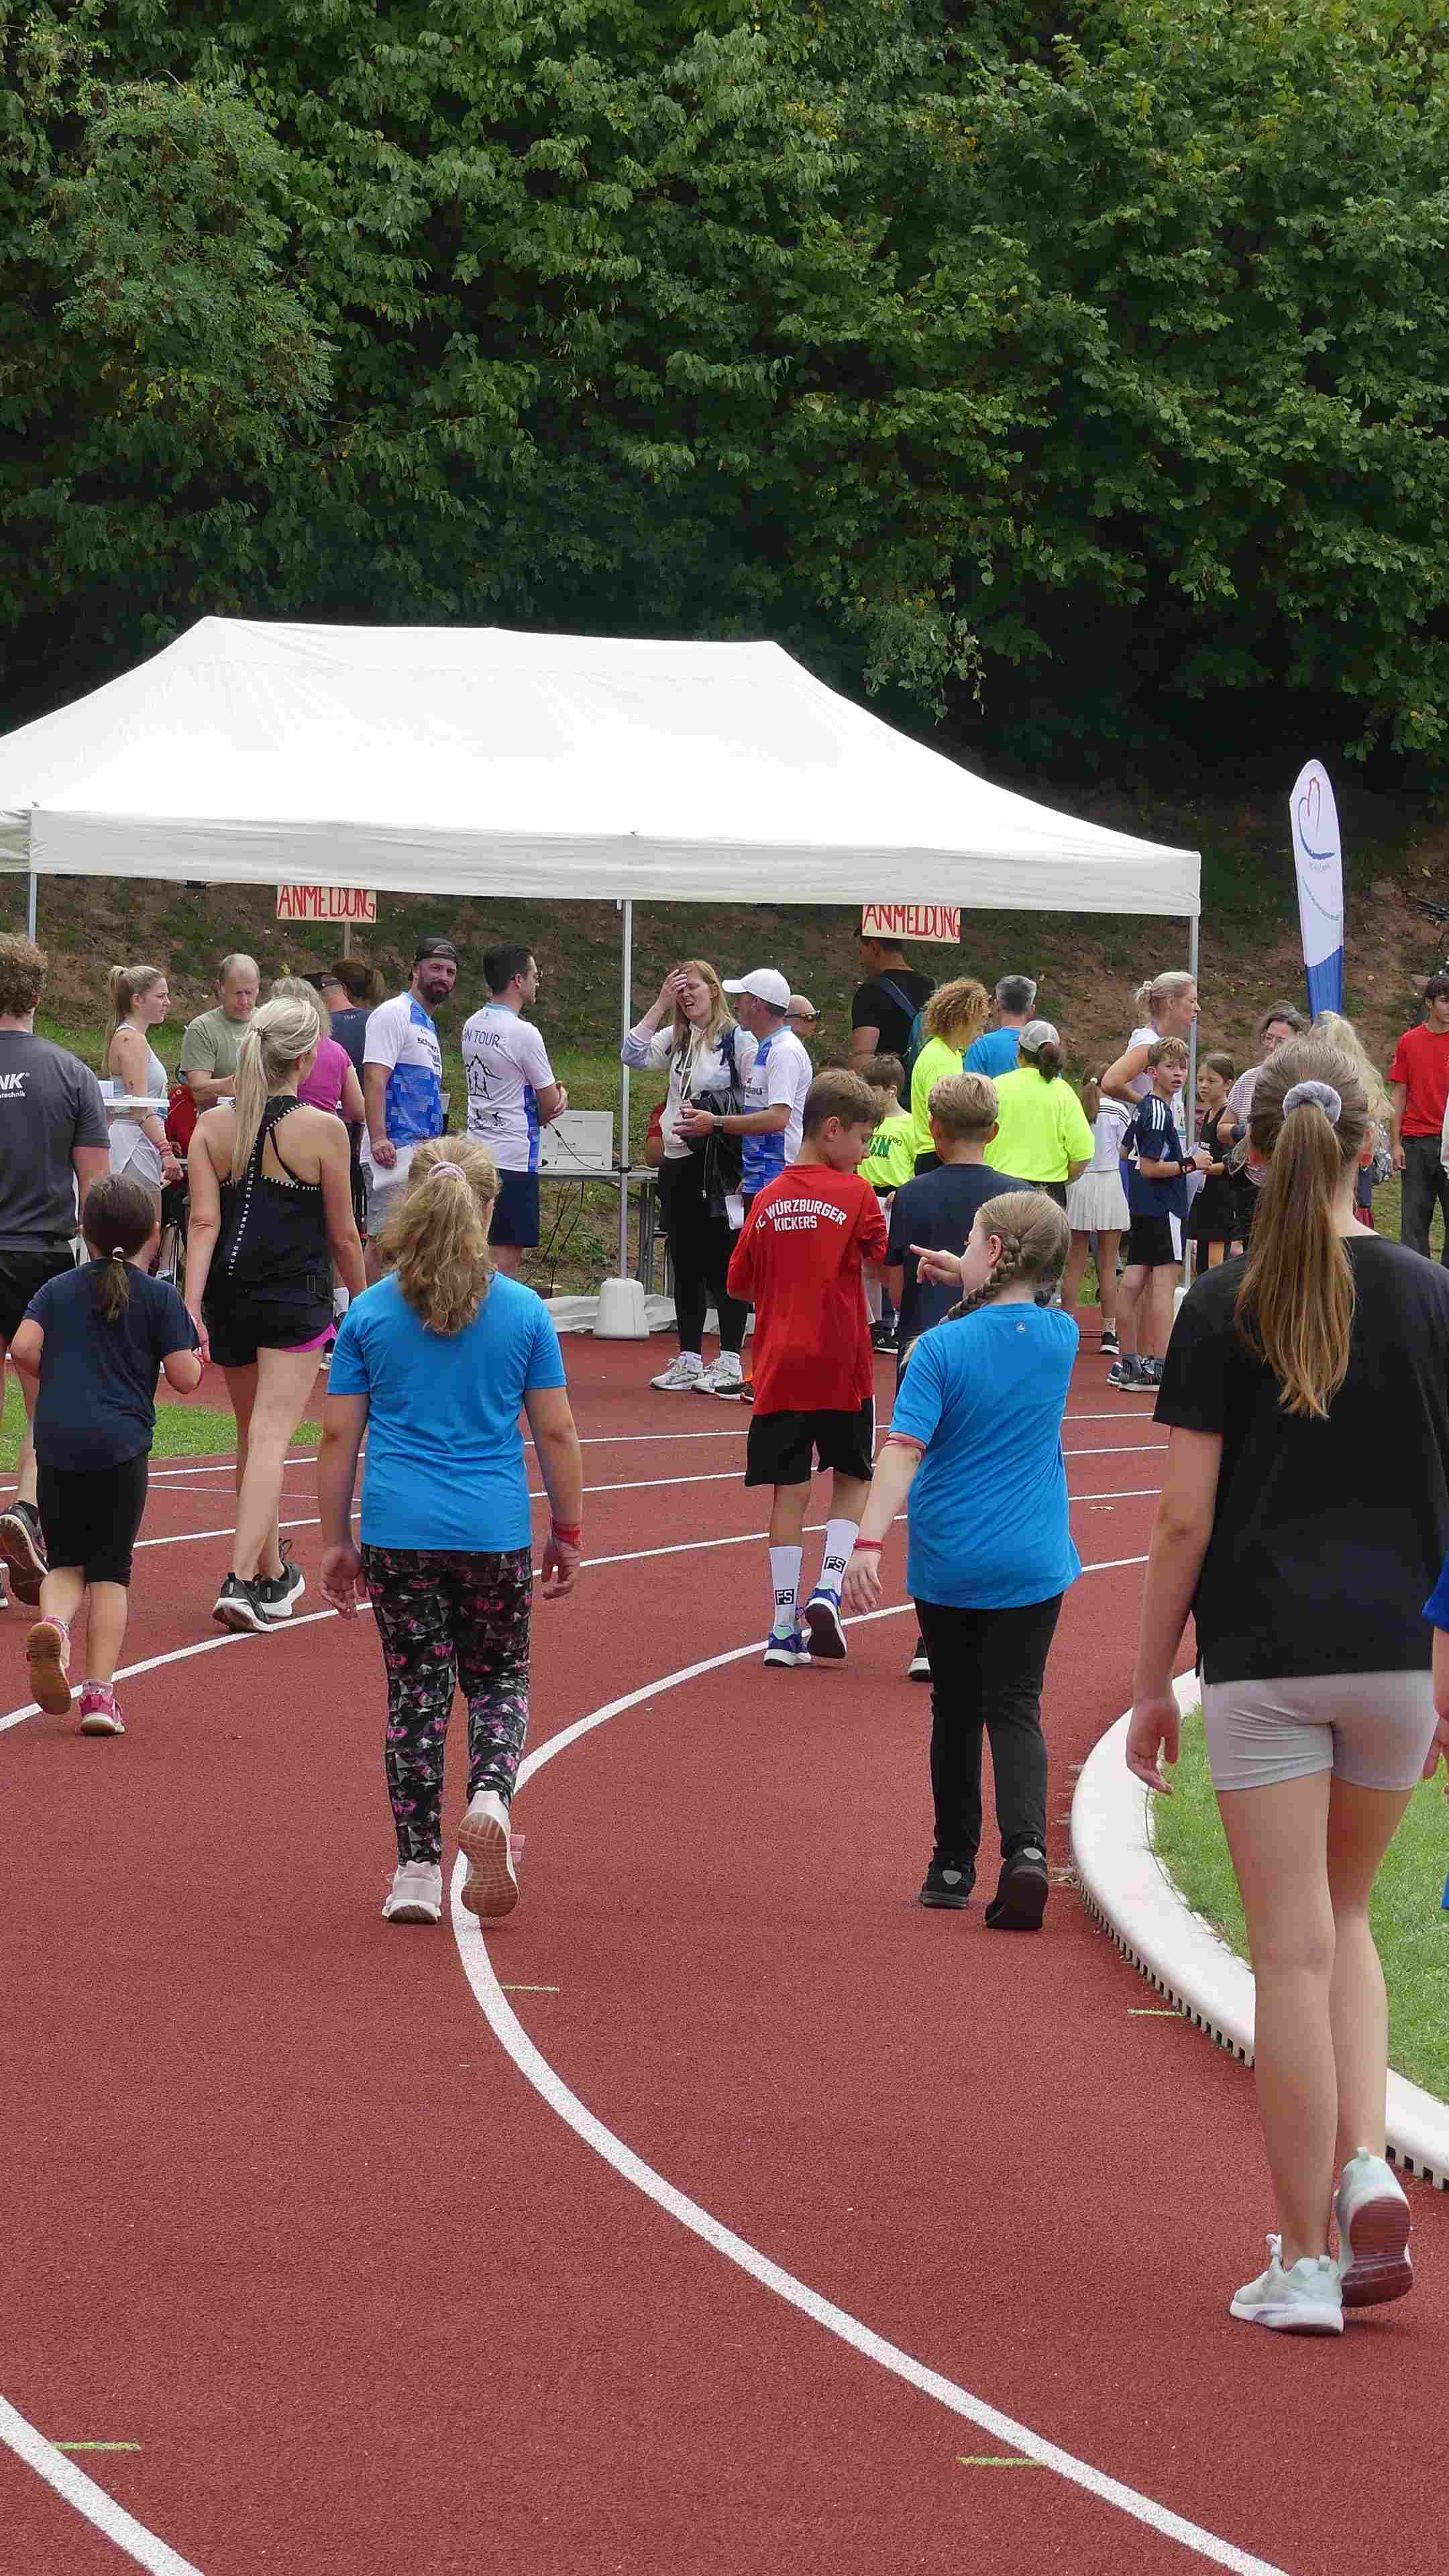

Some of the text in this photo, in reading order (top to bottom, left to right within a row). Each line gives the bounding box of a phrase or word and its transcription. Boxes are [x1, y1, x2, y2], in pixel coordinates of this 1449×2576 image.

[278, 885, 376, 922] ANMELDUNG
[474, 1030, 500, 1047] TOUR
[765, 1199, 847, 1225] WÜRZBURGER
[236, 1203, 250, 1242] ARMOUR
[774, 1216, 817, 1232] KICKERS
[826, 1557, 844, 1572] FS
[776, 1591, 793, 1604] FS
